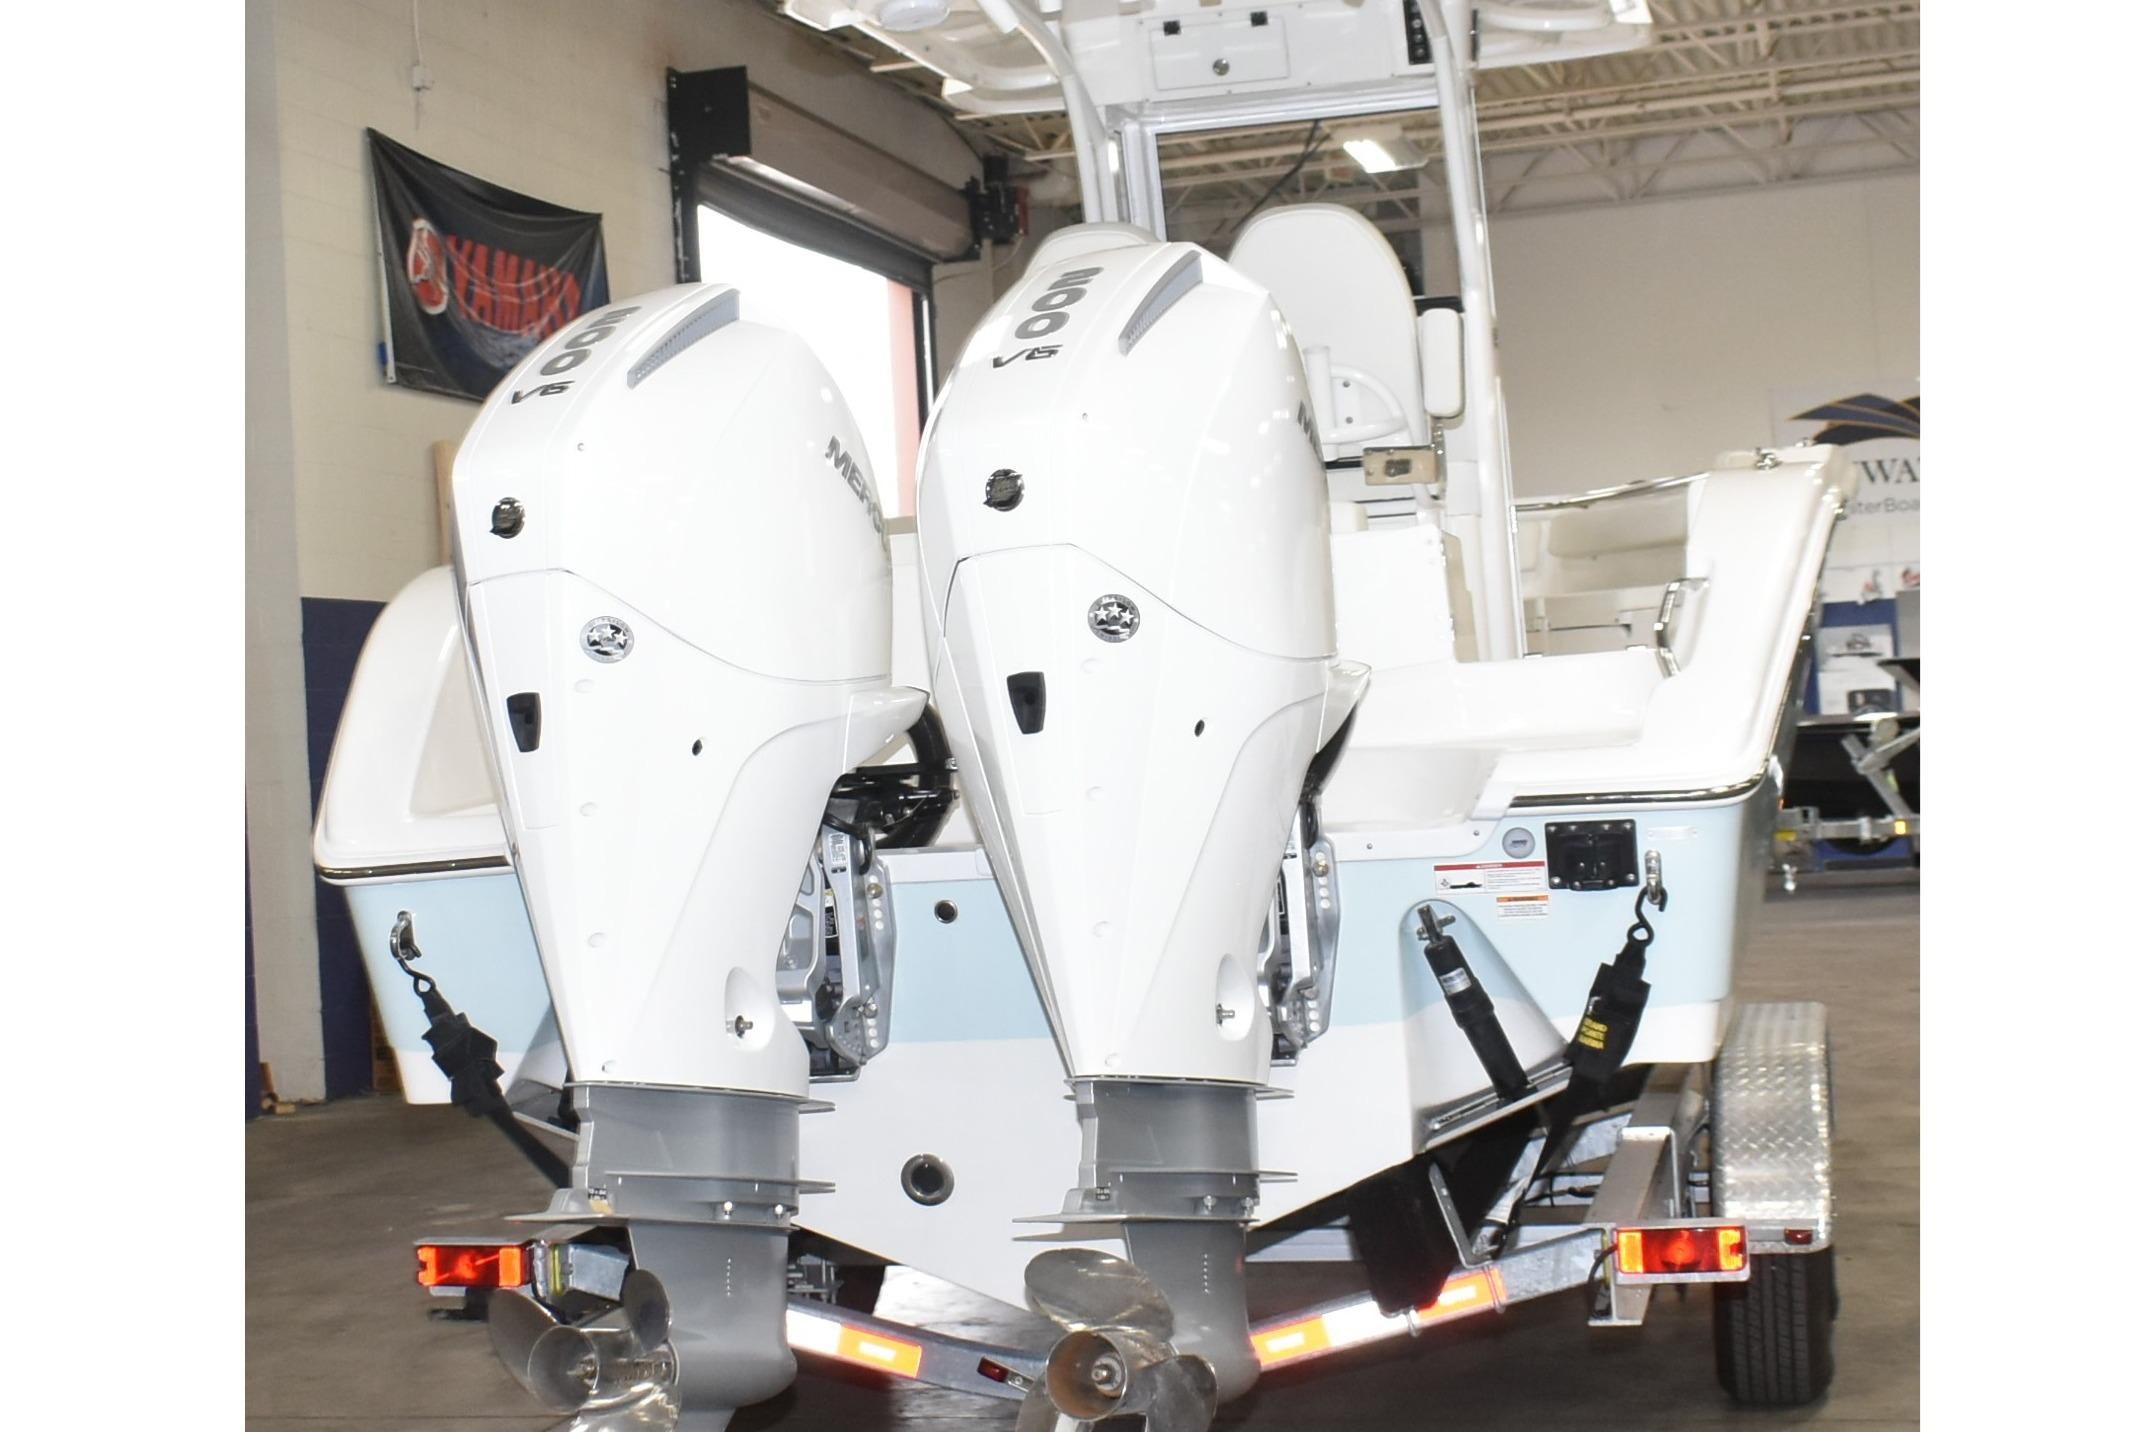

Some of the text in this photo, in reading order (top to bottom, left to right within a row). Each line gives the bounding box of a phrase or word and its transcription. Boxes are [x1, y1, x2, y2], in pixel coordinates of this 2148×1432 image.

[1014, 266, 1105, 340] 200
[992, 344, 1063, 369] V6
[1853, 456, 1920, 484] WA
